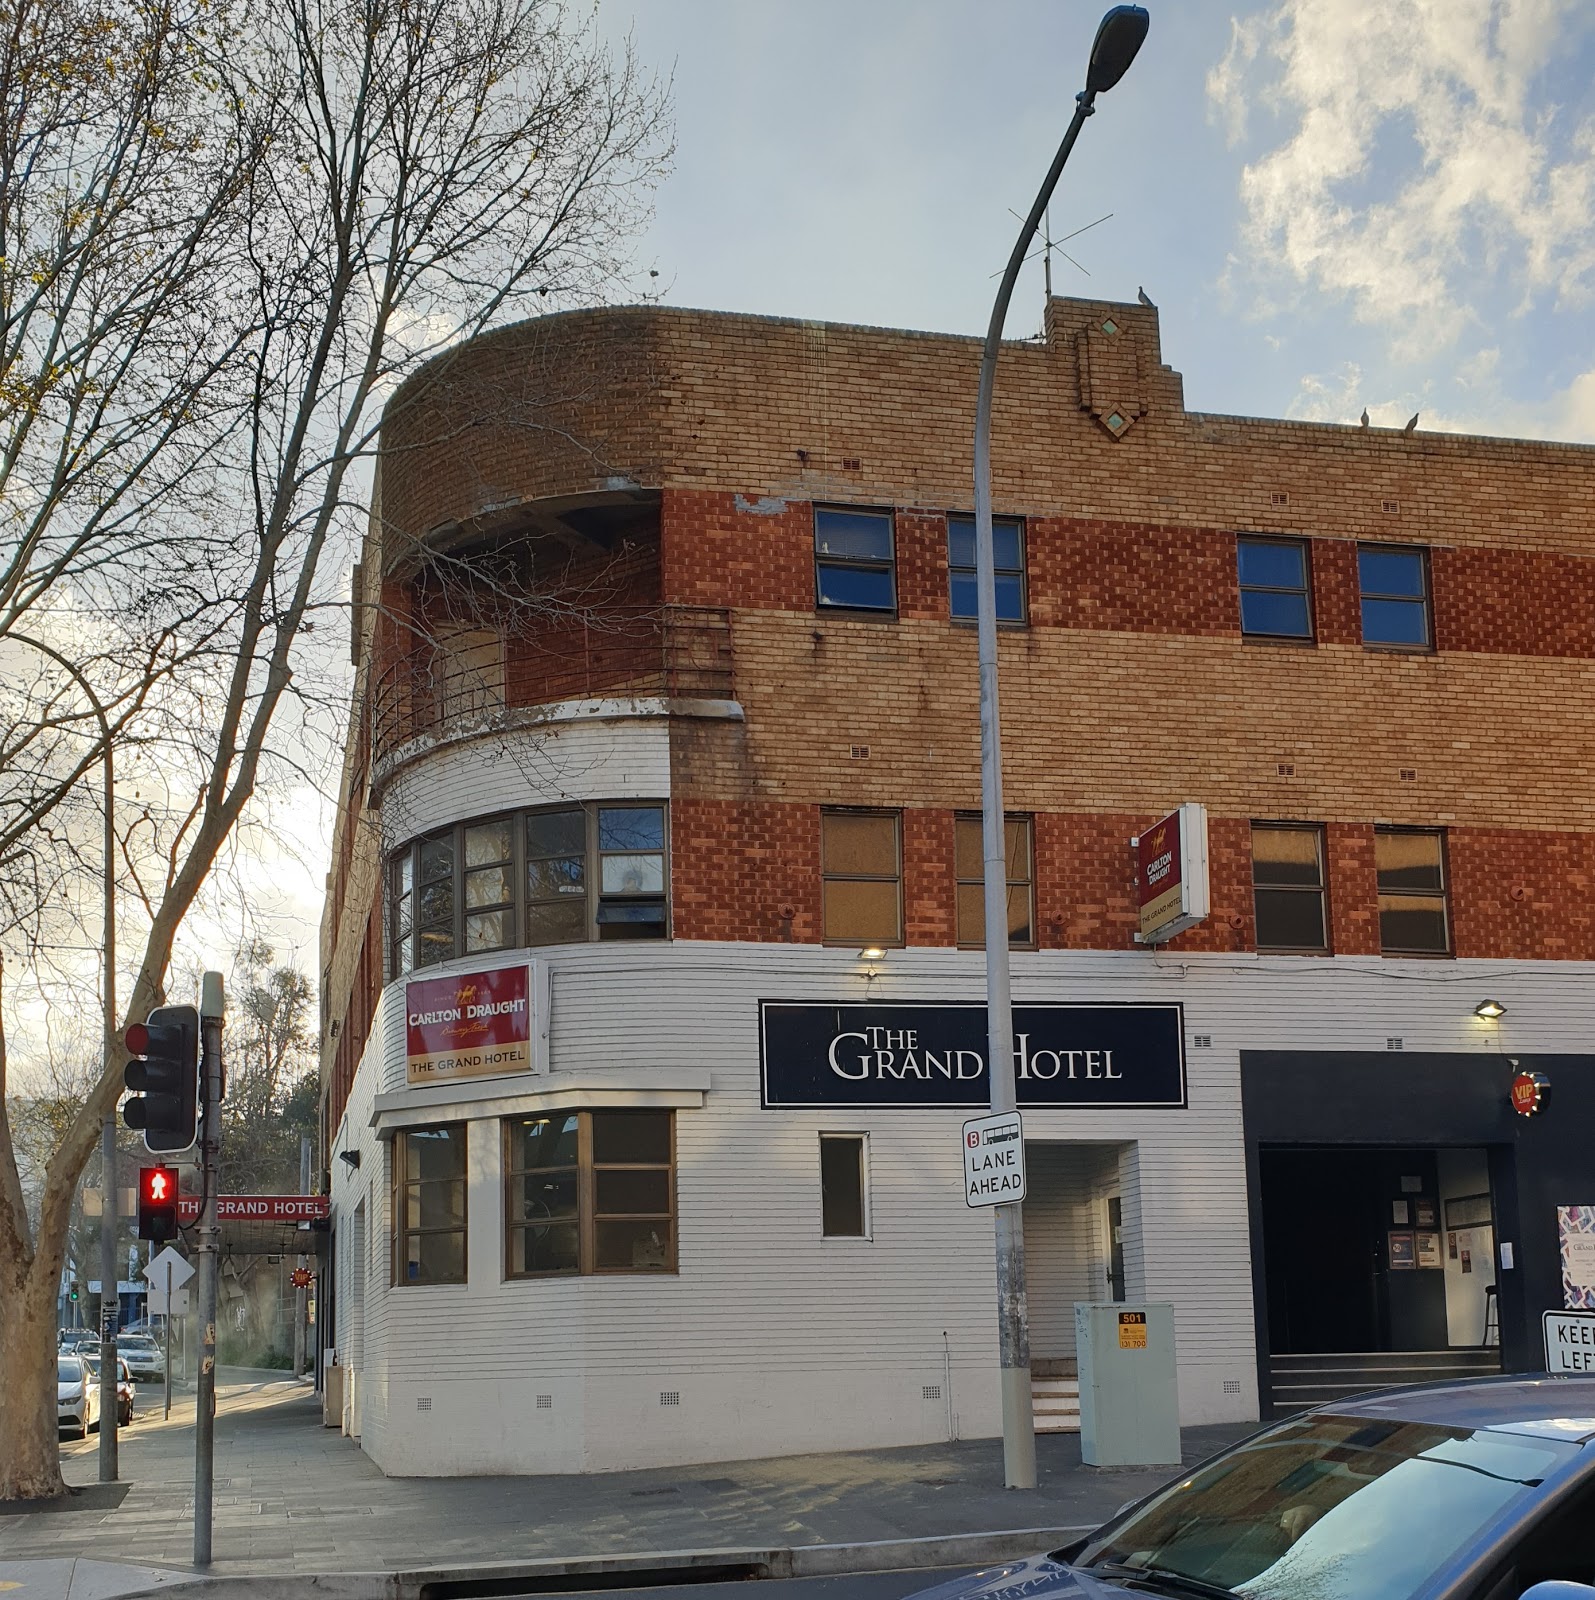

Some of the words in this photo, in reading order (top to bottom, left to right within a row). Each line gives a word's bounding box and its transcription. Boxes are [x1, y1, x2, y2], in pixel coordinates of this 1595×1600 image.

[1146, 851, 1172, 876] CARLTON
[1149, 864, 1170, 885] DRAUGHT
[1142, 915, 1150, 925] THE
[1151, 905, 1166, 919] GRAND
[1167, 897, 1182, 910] HOTEL
[409, 1008, 461, 1026] CARLTON
[467, 999, 525, 1019] DRAUGHT
[865, 1026, 918, 1050] THE
[411, 1062, 435, 1073] THE
[437, 1056, 481, 1070] GRAND
[484, 1051, 525, 1065] HOTEL
[828, 1032, 983, 1080] GRAND
[1515, 1084, 1533, 1099] VIP
[972, 1150, 1016, 1172] LANE
[969, 1173, 1022, 1196] AHEAD
[179, 1202, 199, 1214] TH
[217, 1202, 268, 1214] GRAND
[274, 1202, 323, 1214] HOTEL
[295, 1273, 308, 1281] VIP
[1123, 1314, 1141, 1323] 501
[1557, 1324, 1595, 1346] KEE
[1561, 1350, 1595, 1370] LEF
